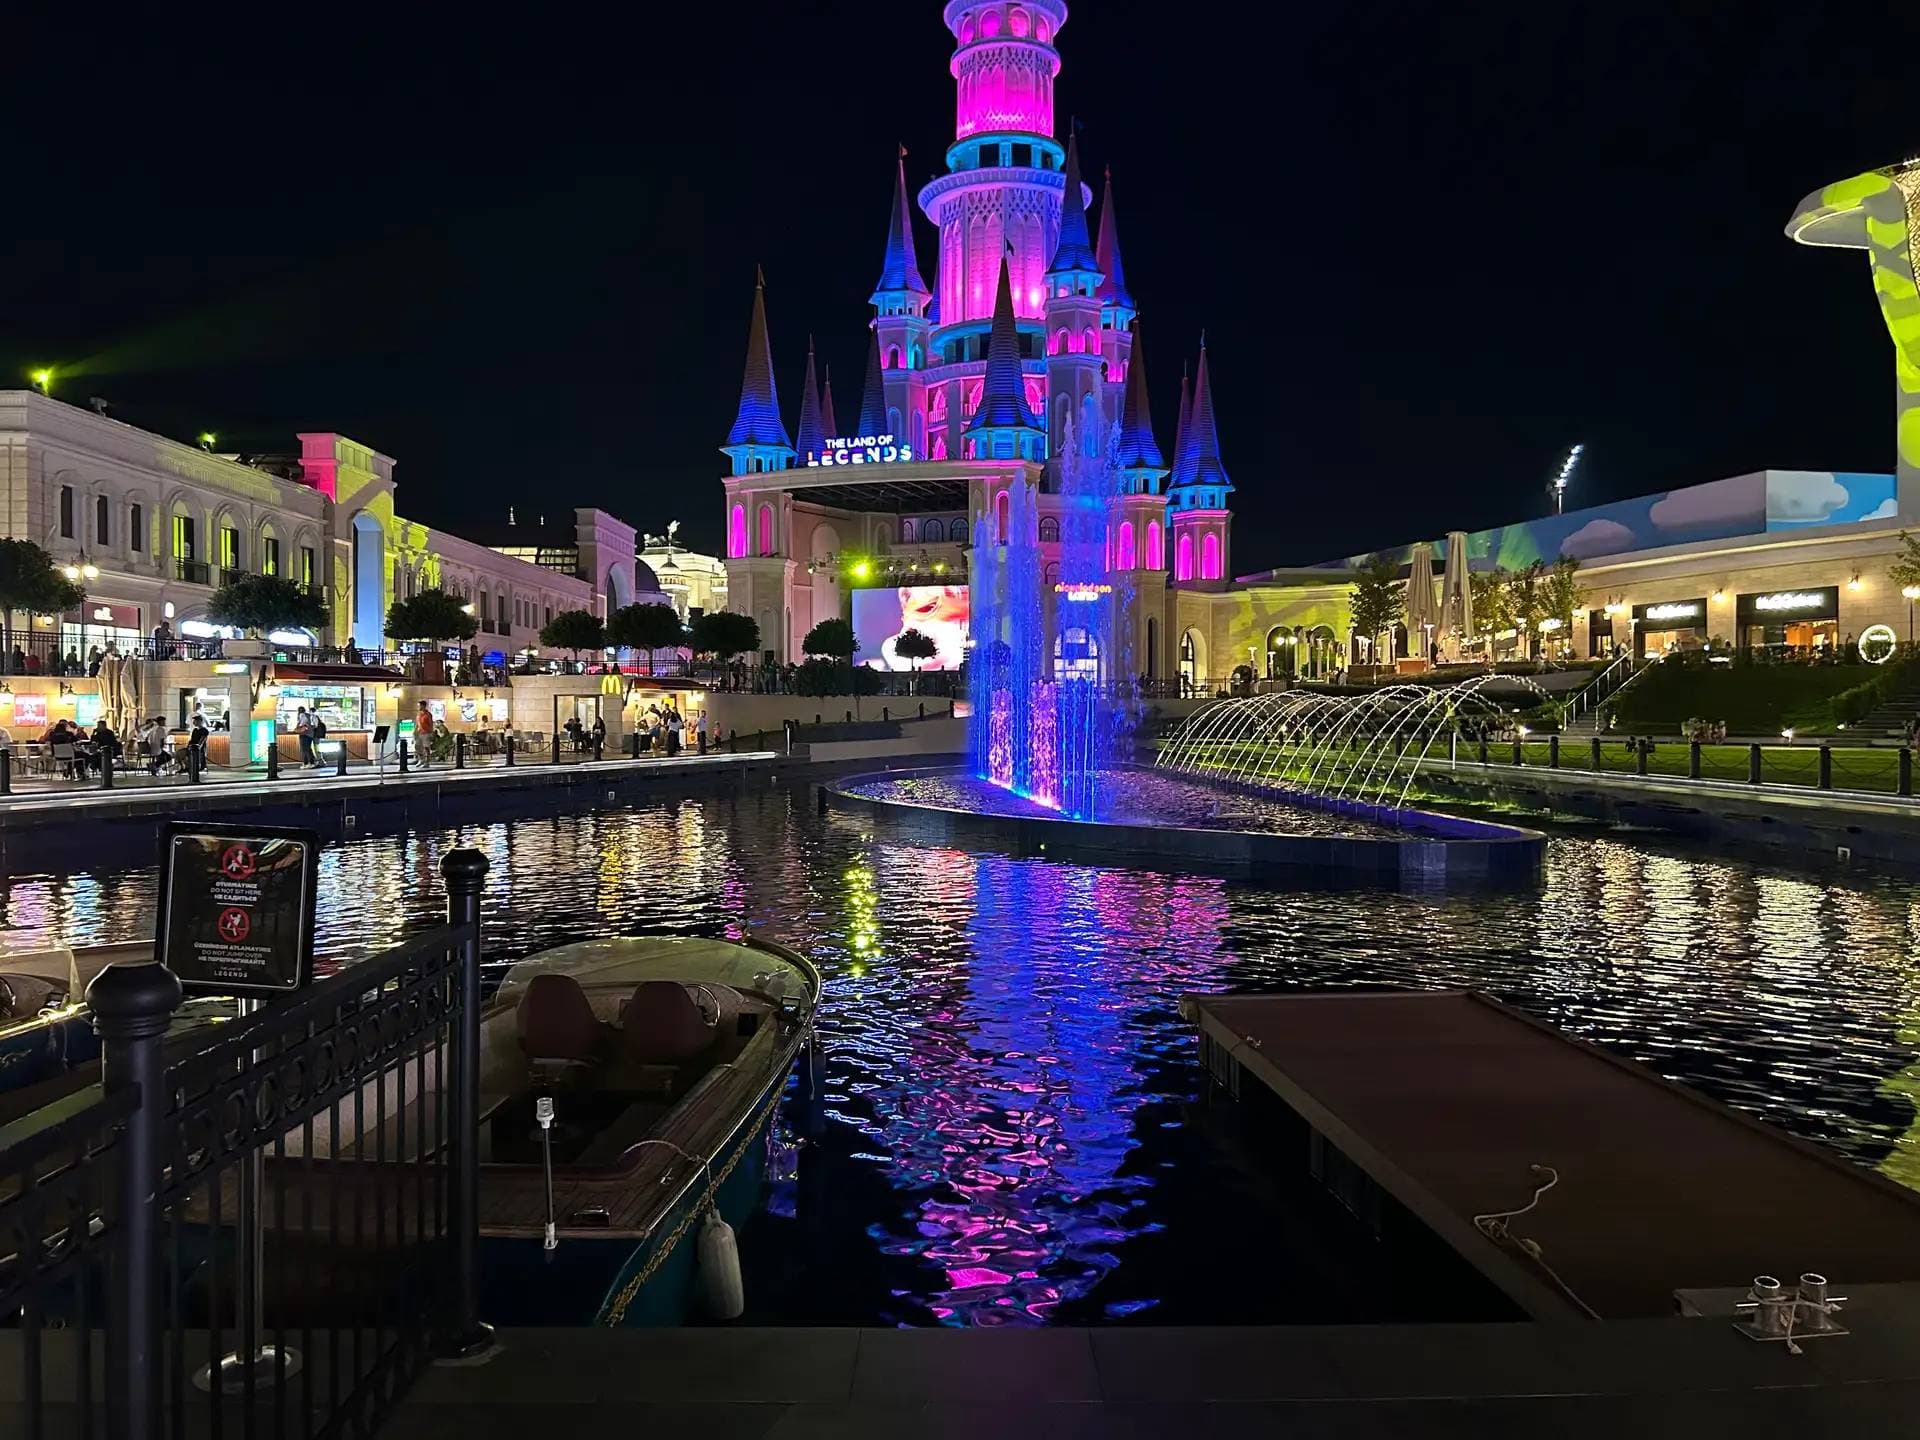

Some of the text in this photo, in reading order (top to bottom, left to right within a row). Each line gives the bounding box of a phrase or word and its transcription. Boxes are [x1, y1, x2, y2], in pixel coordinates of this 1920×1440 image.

[825, 434, 894, 449] THE LAND OF
[807, 444, 912, 467] LEGENDS
[214, 970, 248, 978] LEGENDS
